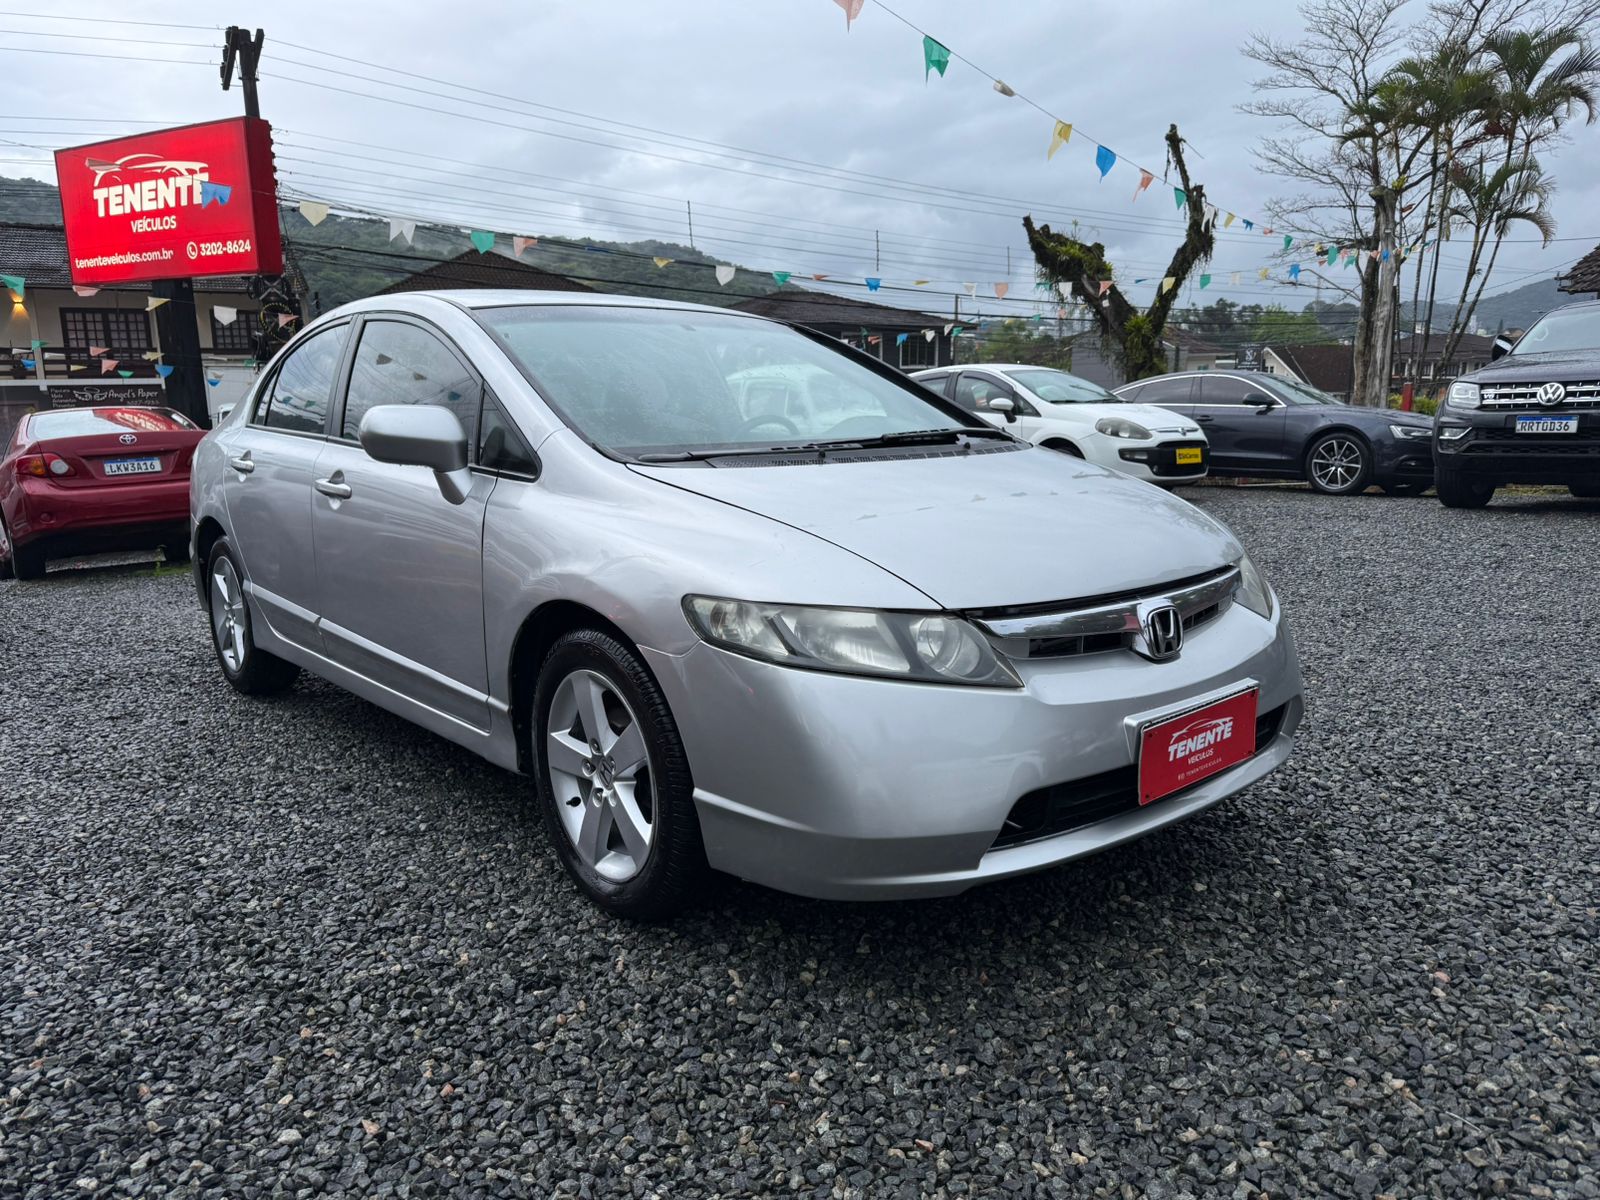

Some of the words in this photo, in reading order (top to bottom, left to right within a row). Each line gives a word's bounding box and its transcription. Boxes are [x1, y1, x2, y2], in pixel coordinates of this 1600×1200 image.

[93, 173, 209, 218] TENENTE
[130, 215, 177, 233] VEÍCULOS
[199, 239, 252, 257] 3202-8624
[75, 248, 174, 269] tenenteveiculos.com.br
[108, 389, 136, 402] Angel's
[137, 388, 159, 399] Paper
[109, 461, 156, 474] LKW3A16
[1167, 721, 1234, 762] TENENTE
